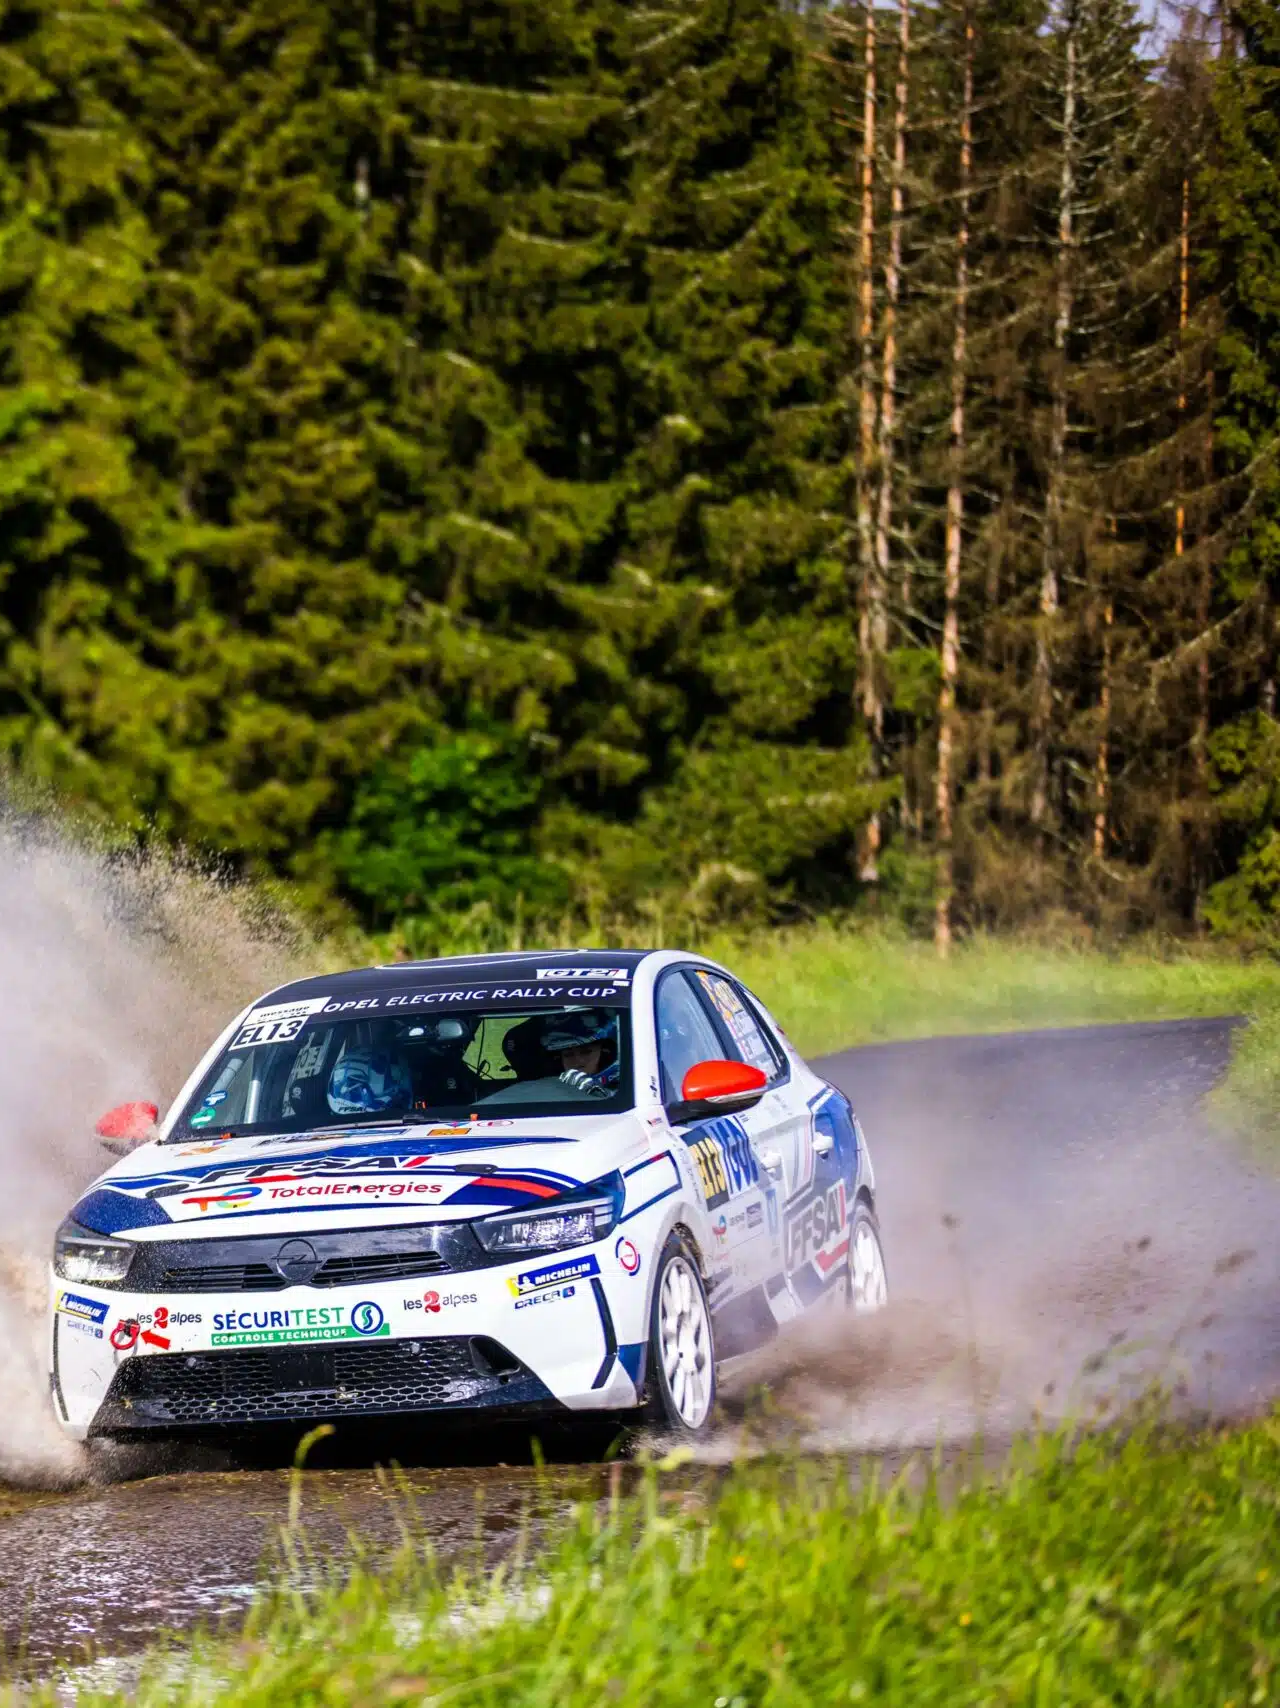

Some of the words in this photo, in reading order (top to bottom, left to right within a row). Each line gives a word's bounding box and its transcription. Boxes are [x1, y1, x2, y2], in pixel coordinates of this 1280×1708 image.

[323, 998, 380, 1013] OPEL
[386, 989, 488, 1007] ELECTRIC
[491, 987, 564, 999] RALLY
[567, 987, 617, 998] CUP
[233, 1019, 302, 1047] EL13
[198, 1156, 397, 1184] FFSA
[269, 1182, 443, 1199] TotalEnergies
[535, 1262, 591, 1285] MICHELIN
[403, 1298, 423, 1311] les
[423, 1290, 441, 1314] 2
[442, 1292, 478, 1308] alpes
[136, 1312, 153, 1324] les
[153, 1306, 169, 1329] 2
[169, 1311, 202, 1325] alpes
[213, 1306, 345, 1331] SÉCURITEST
[213, 1332, 274, 1344] CONTROLE
[278, 1328, 347, 1340] TECHNIQUE
